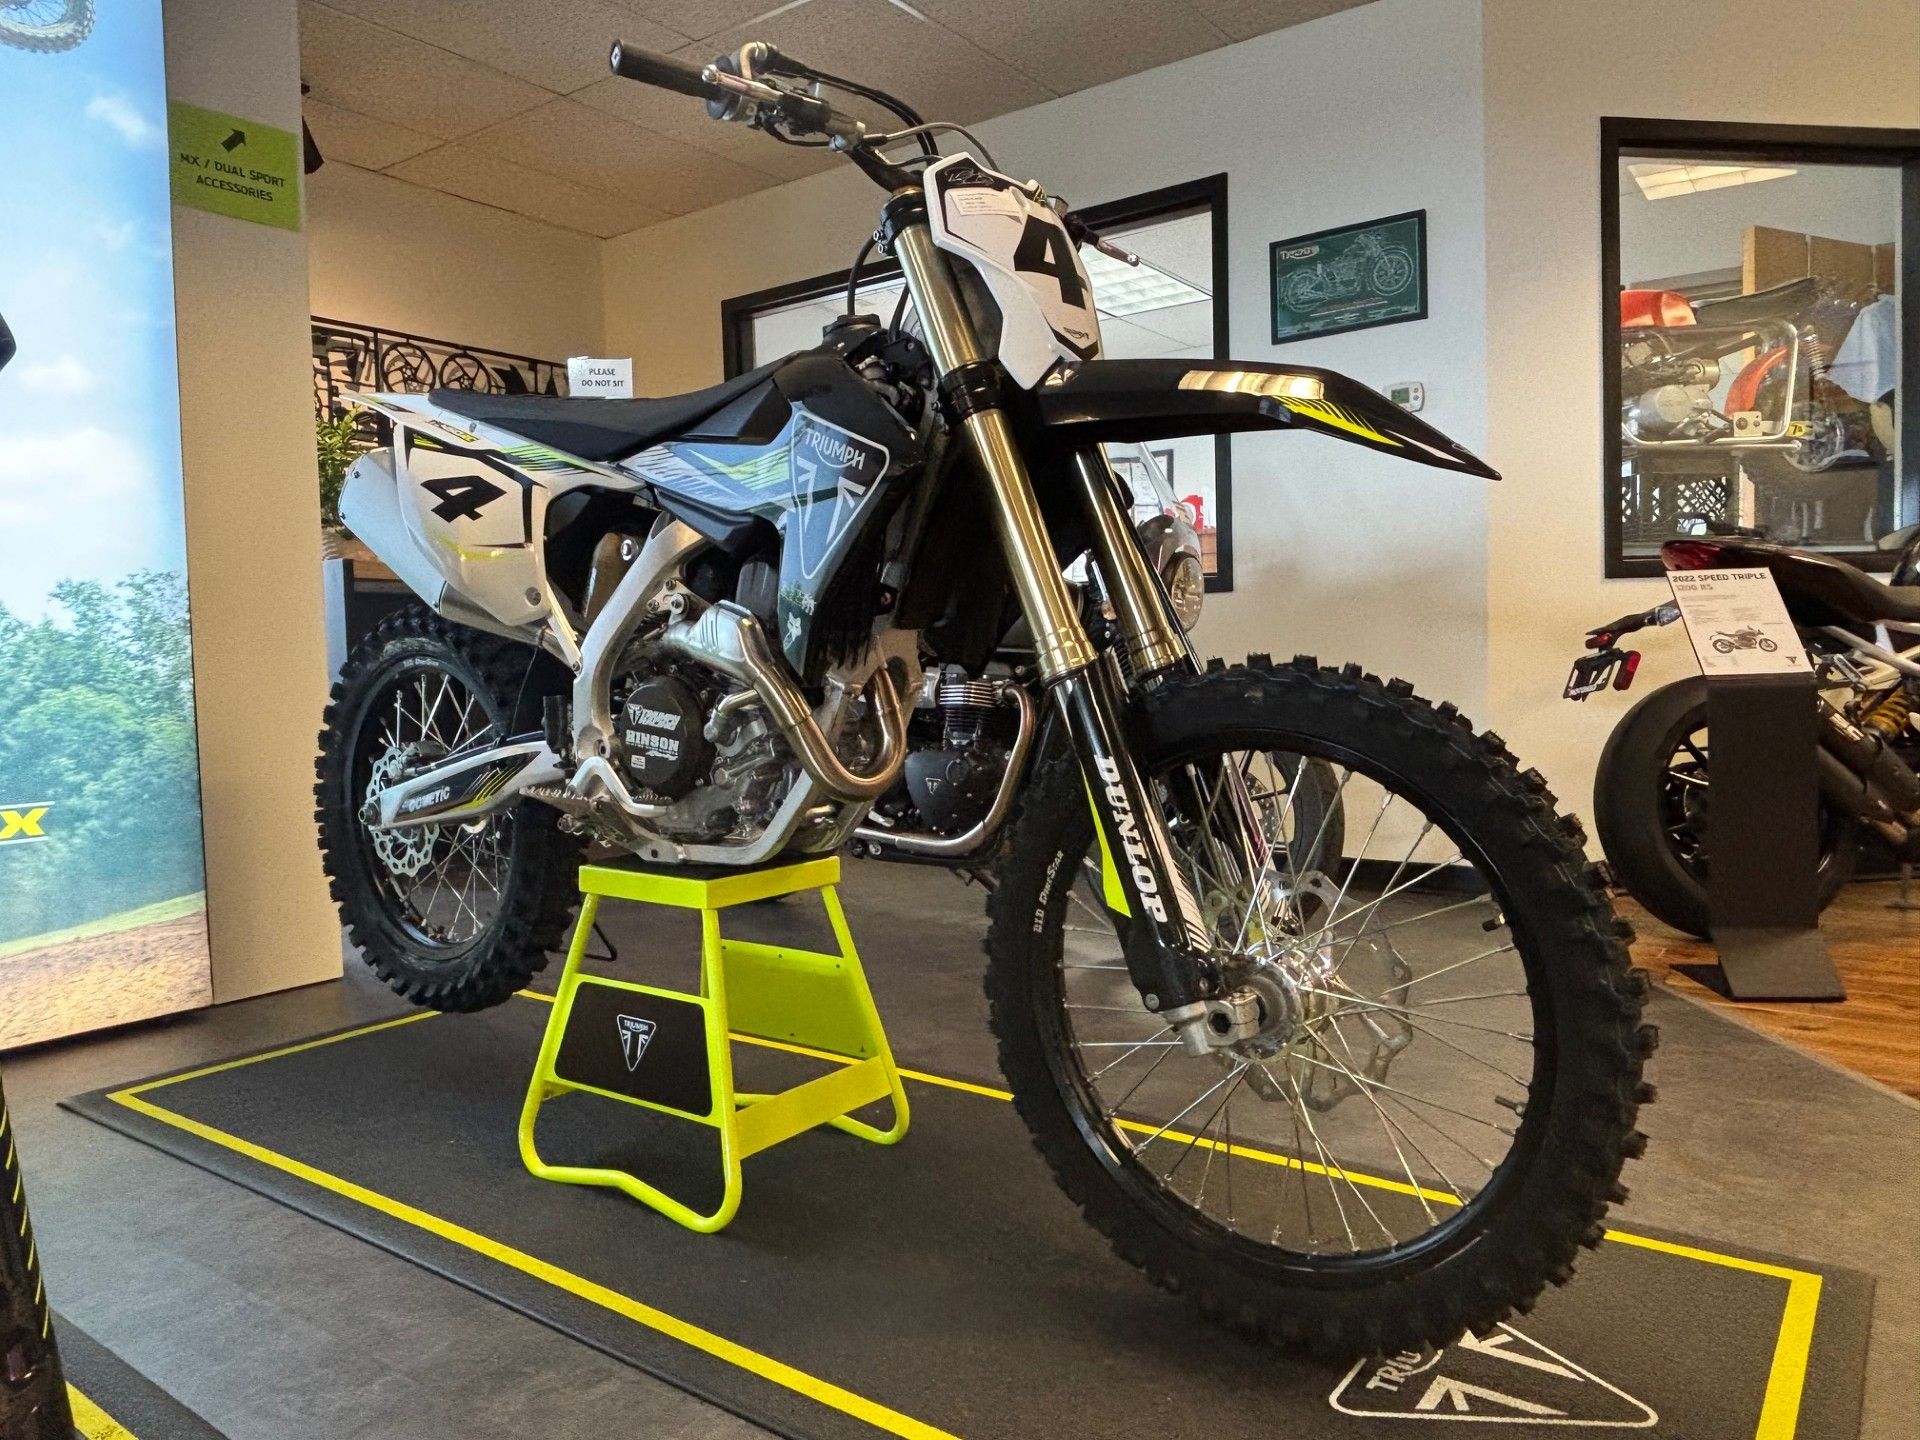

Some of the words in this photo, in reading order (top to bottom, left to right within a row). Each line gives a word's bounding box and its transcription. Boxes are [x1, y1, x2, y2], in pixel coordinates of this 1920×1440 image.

[180, 152, 201, 167] MX
[214, 160, 246, 178] DUAL
[249, 169, 286, 187] SPORT
[195, 174, 274, 202] ACCESSORIES
[1013, 214, 1088, 310] 4
[581, 379, 593, 387] DO
[594, 379, 610, 387] NOT
[588, 368, 616, 376] PLEASE
[803, 427, 866, 470] TRIUMPH
[420, 475, 507, 524] 4
[1672, 574, 1696, 583] 2022
[1698, 573, 1729, 582] SPEED
[1733, 572, 1767, 581] TRIPLE
[625, 729, 680, 752] HINSON
[1094, 754, 1168, 923] DUNLOP
[1365, 1350, 1443, 1392] TRIU
